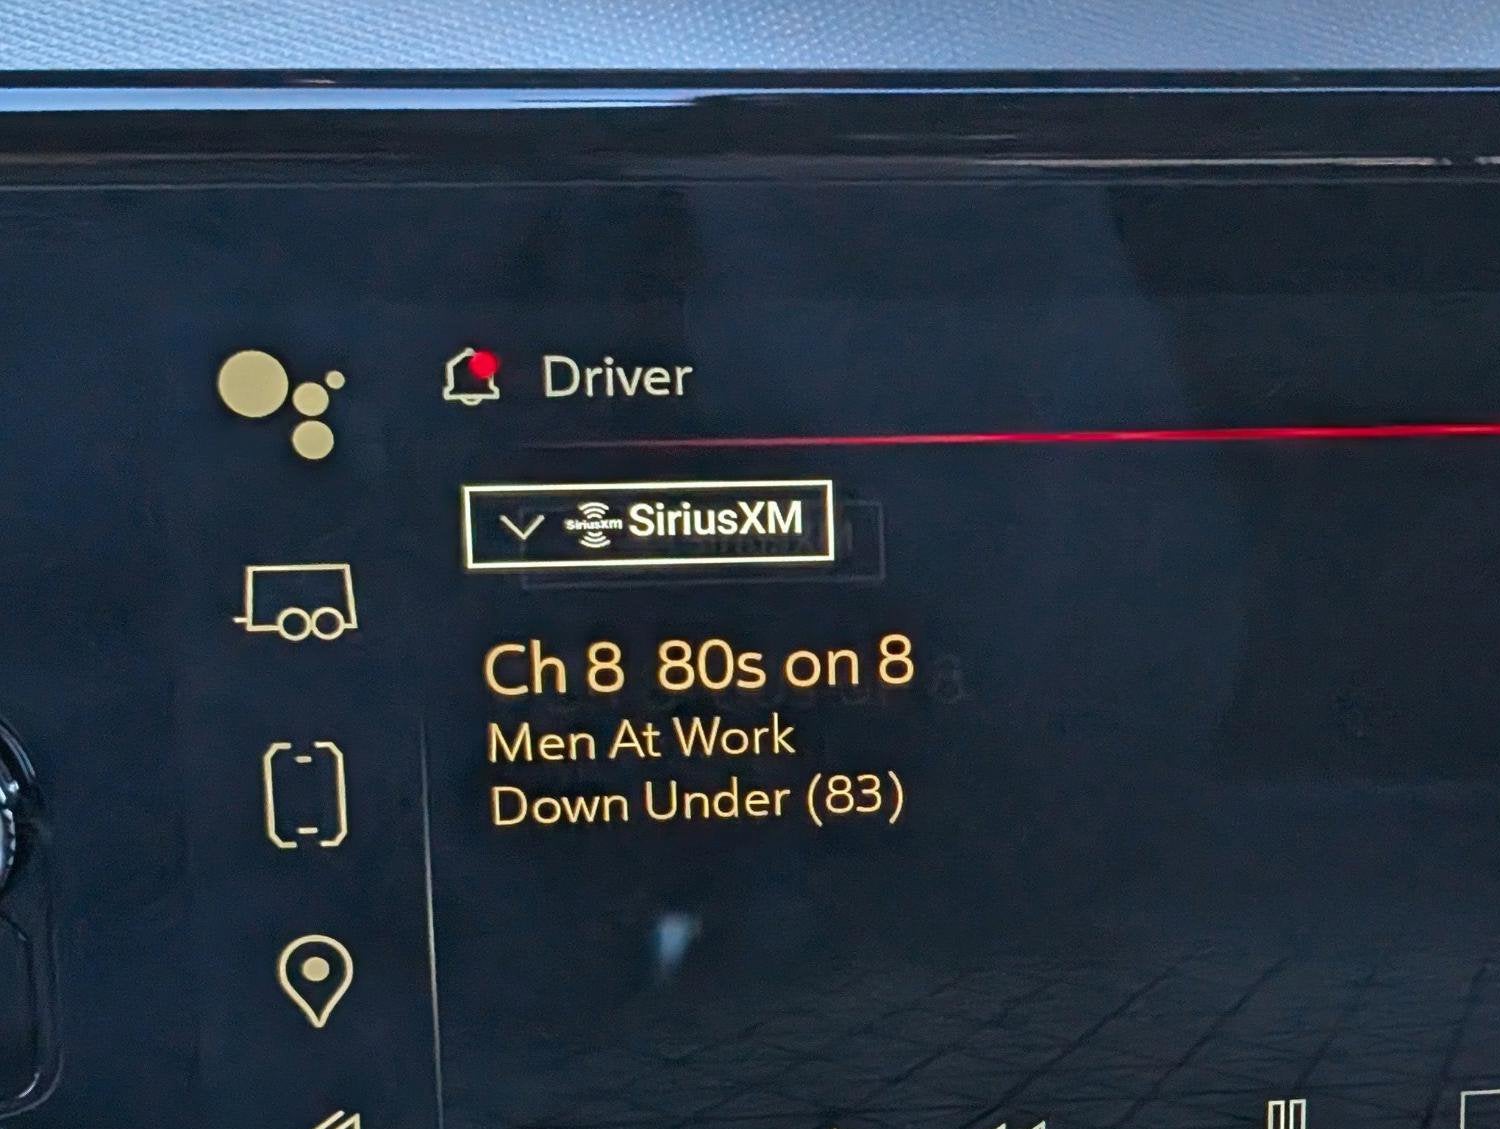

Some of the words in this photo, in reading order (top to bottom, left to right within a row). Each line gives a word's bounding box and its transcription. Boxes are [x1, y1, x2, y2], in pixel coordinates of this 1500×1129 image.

[543, 355, 693, 398] Driver
[628, 500, 803, 537] SiriusXM
[485, 639, 567, 696] Ch
[587, 641, 625, 693] 8
[658, 638, 767, 691] 80s
[785, 649, 859, 688] on
[879, 633, 914, 685] 8
[489, 721, 596, 763] Men
[608, 718, 662, 759] At
[672, 711, 796, 757] Work
[492, 786, 629, 826] Down
[645, 776, 791, 820] Under
[807, 770, 904, 827] (83)
